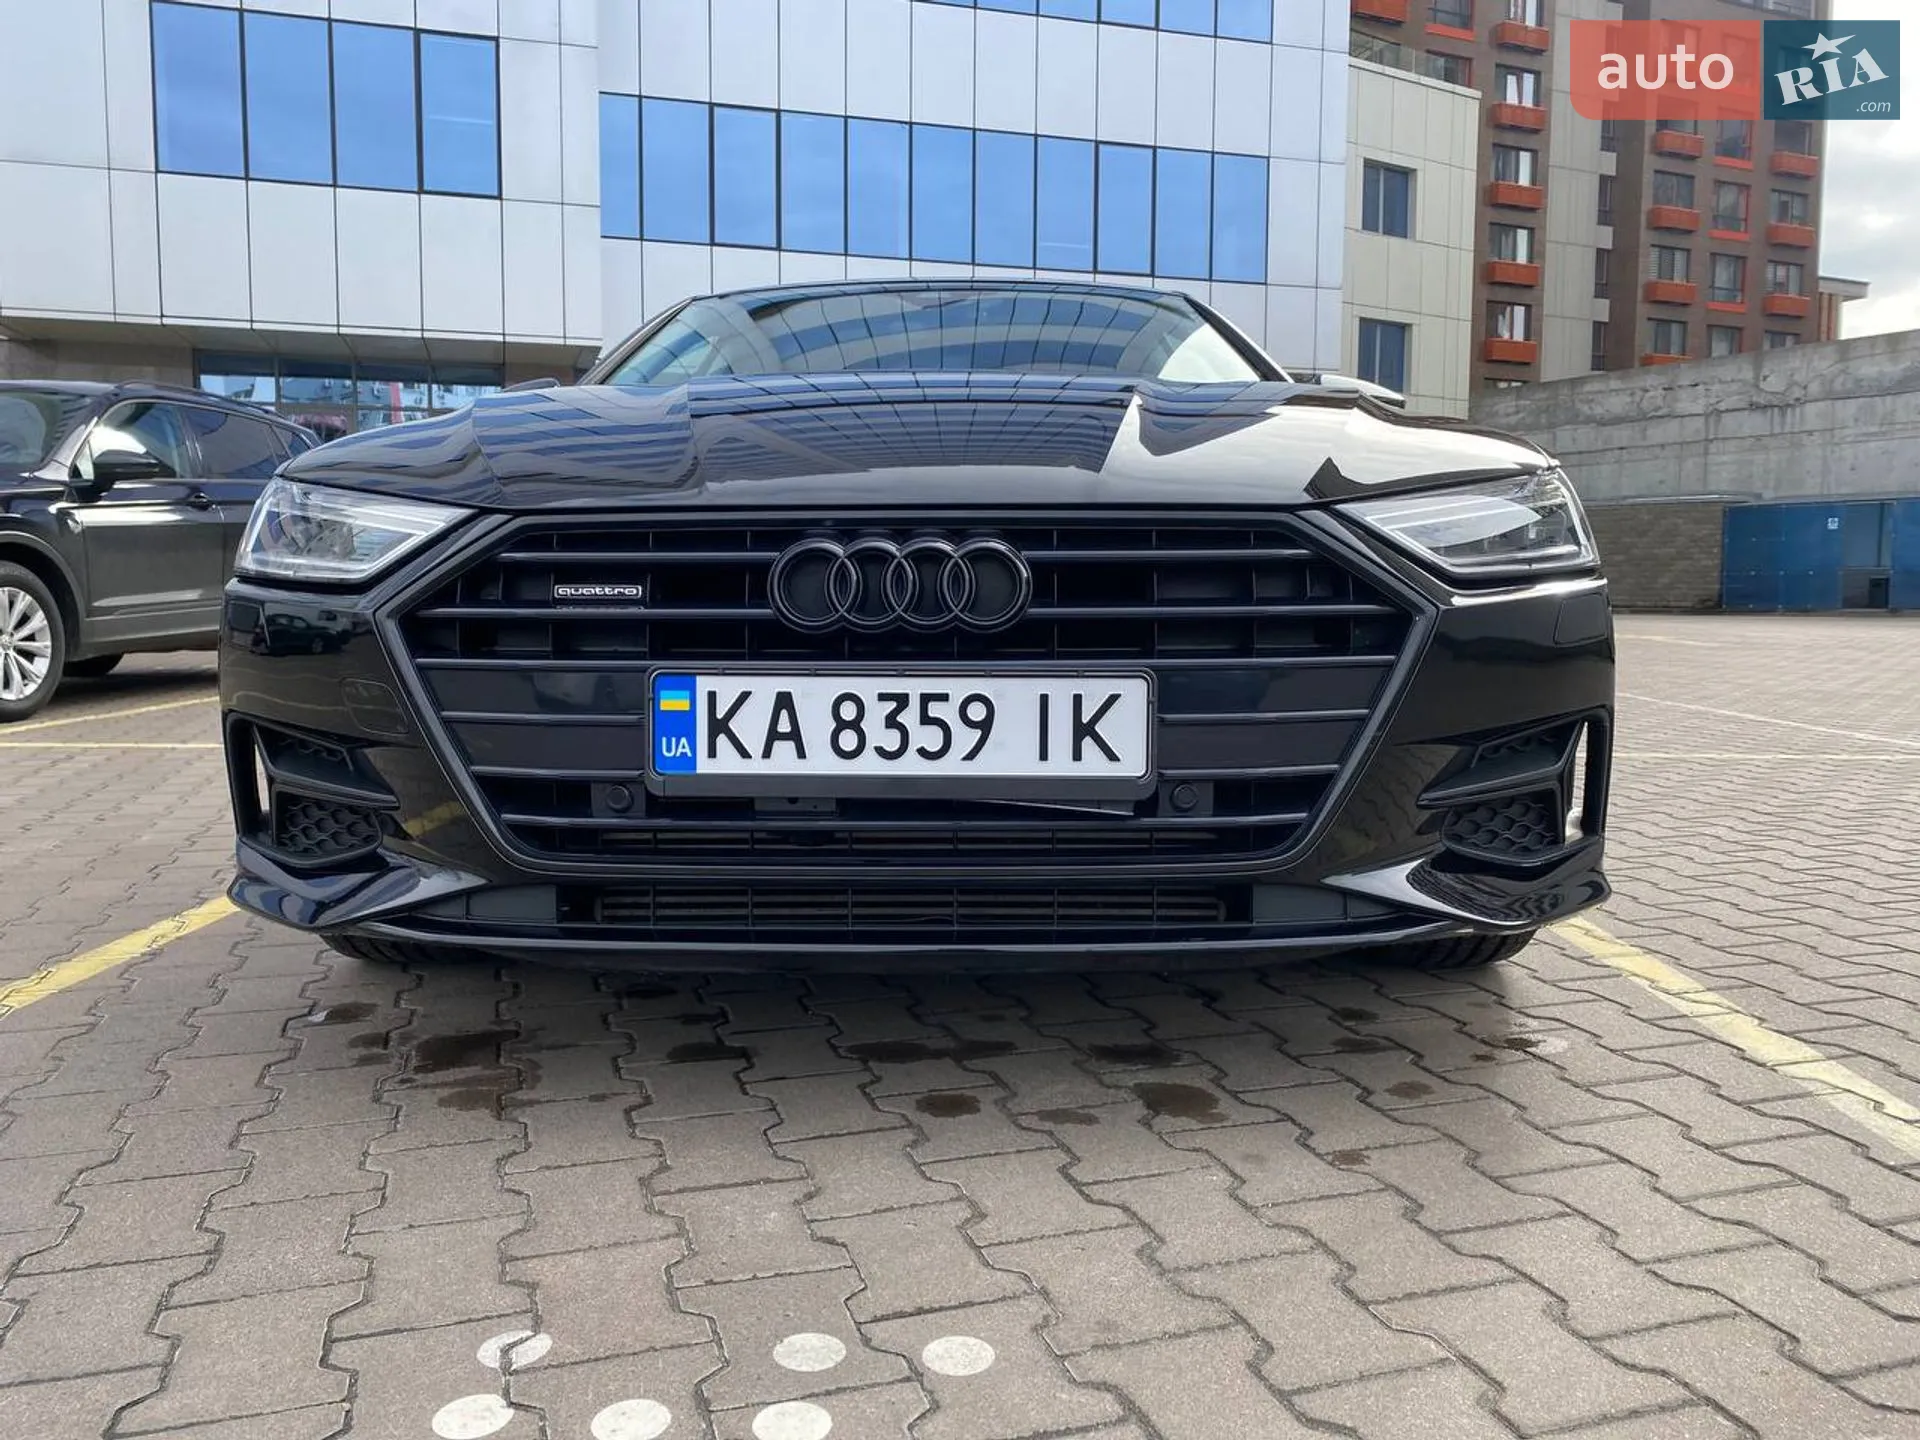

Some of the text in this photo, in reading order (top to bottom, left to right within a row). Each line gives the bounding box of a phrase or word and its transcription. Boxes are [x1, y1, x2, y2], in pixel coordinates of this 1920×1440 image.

[558, 587, 638, 598] quattro
[707, 690, 1123, 762] KA 8359 IK
[662, 736, 692, 758] UA
